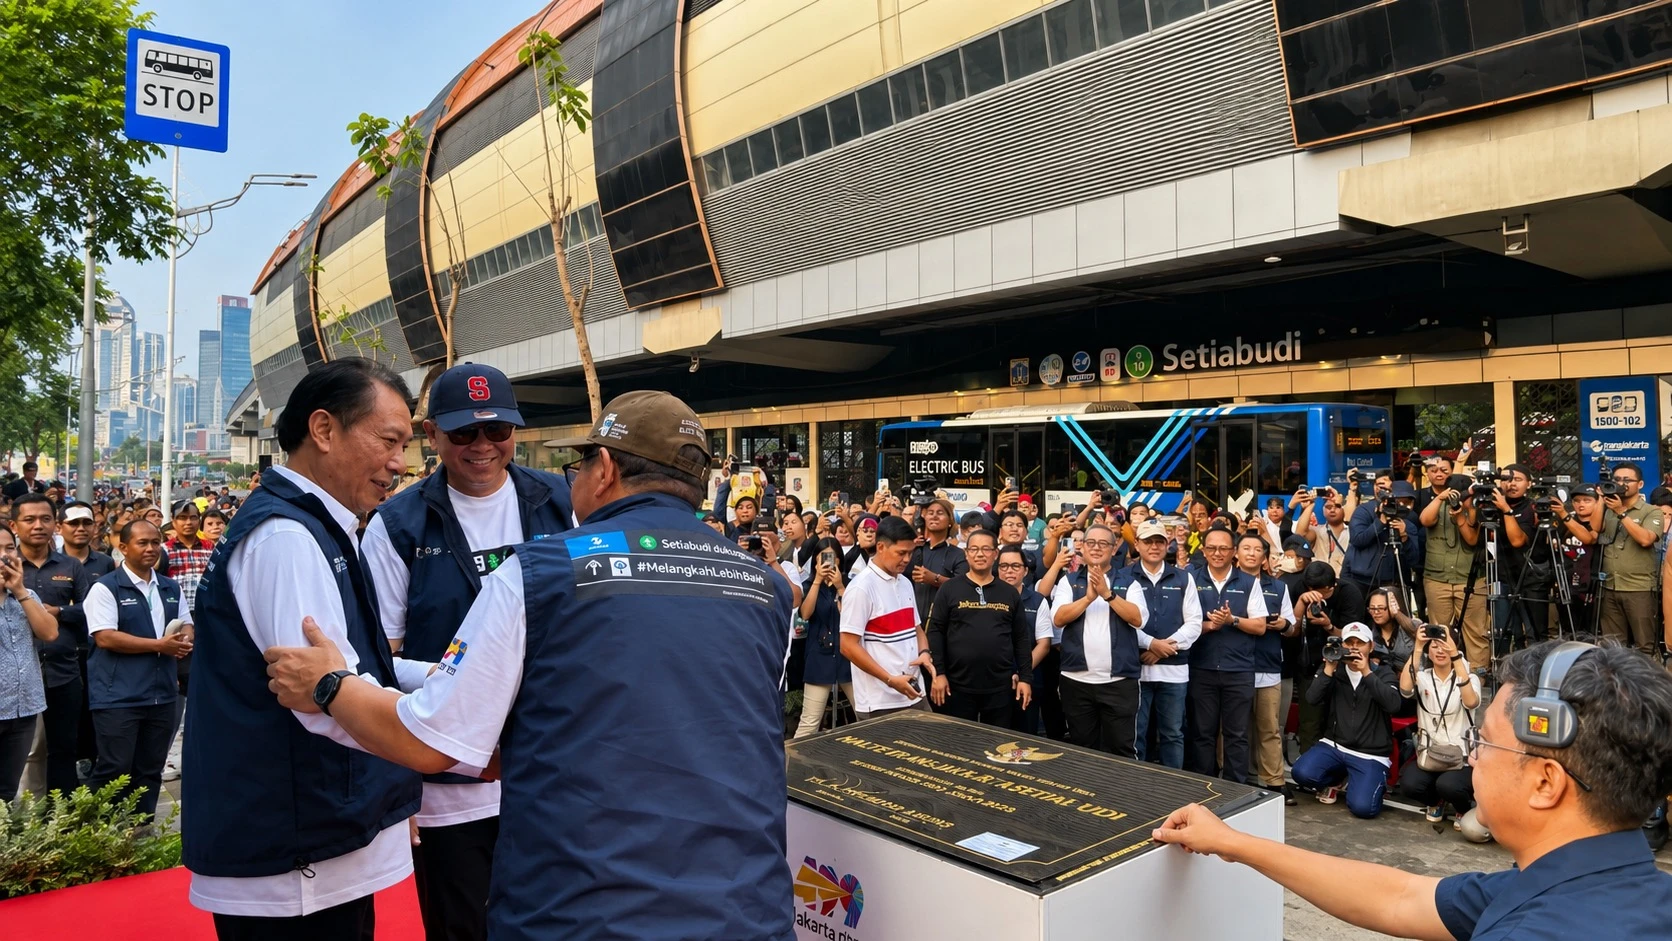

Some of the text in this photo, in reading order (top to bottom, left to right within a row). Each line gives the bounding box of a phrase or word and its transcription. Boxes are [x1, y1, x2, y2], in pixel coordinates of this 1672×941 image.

[143, 83, 214, 114] STOP
[1162, 330, 1301, 372] Setiabudi
[1133, 361, 1145, 372] 10
[467, 376, 491, 401] S
[1595, 416, 1641, 426] 1500-102
[909, 460, 985, 474] ELECTRIC BUS
[661, 539, 712, 552] Setiabudi
